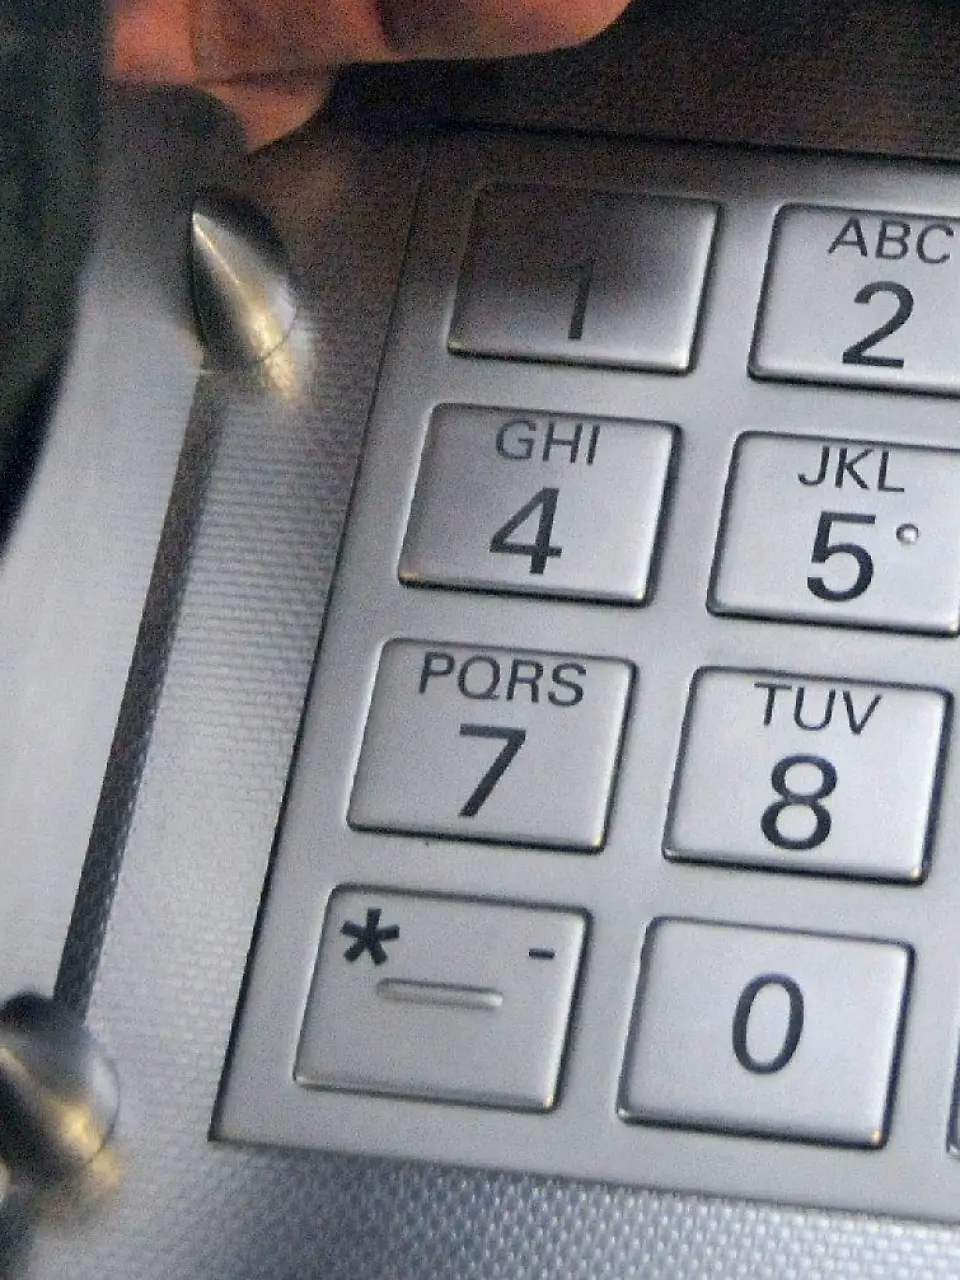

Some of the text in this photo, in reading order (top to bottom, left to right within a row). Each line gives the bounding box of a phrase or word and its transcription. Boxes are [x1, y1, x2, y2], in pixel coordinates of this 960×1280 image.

[827, 216, 955, 264] ABC
[842, 281, 915, 370] 2
[495, 418, 601, 466] GHI
[797, 444, 906, 493] JKL
[488, 486, 563, 575] 4
[806, 511, 877, 602] 5
[417, 651, 588, 707] PQRS
[753, 681, 883, 736] TUV
[458, 723, 527, 818] 7
[759, 753, 839, 850] 8
[731, 973, 805, 1075] 0
